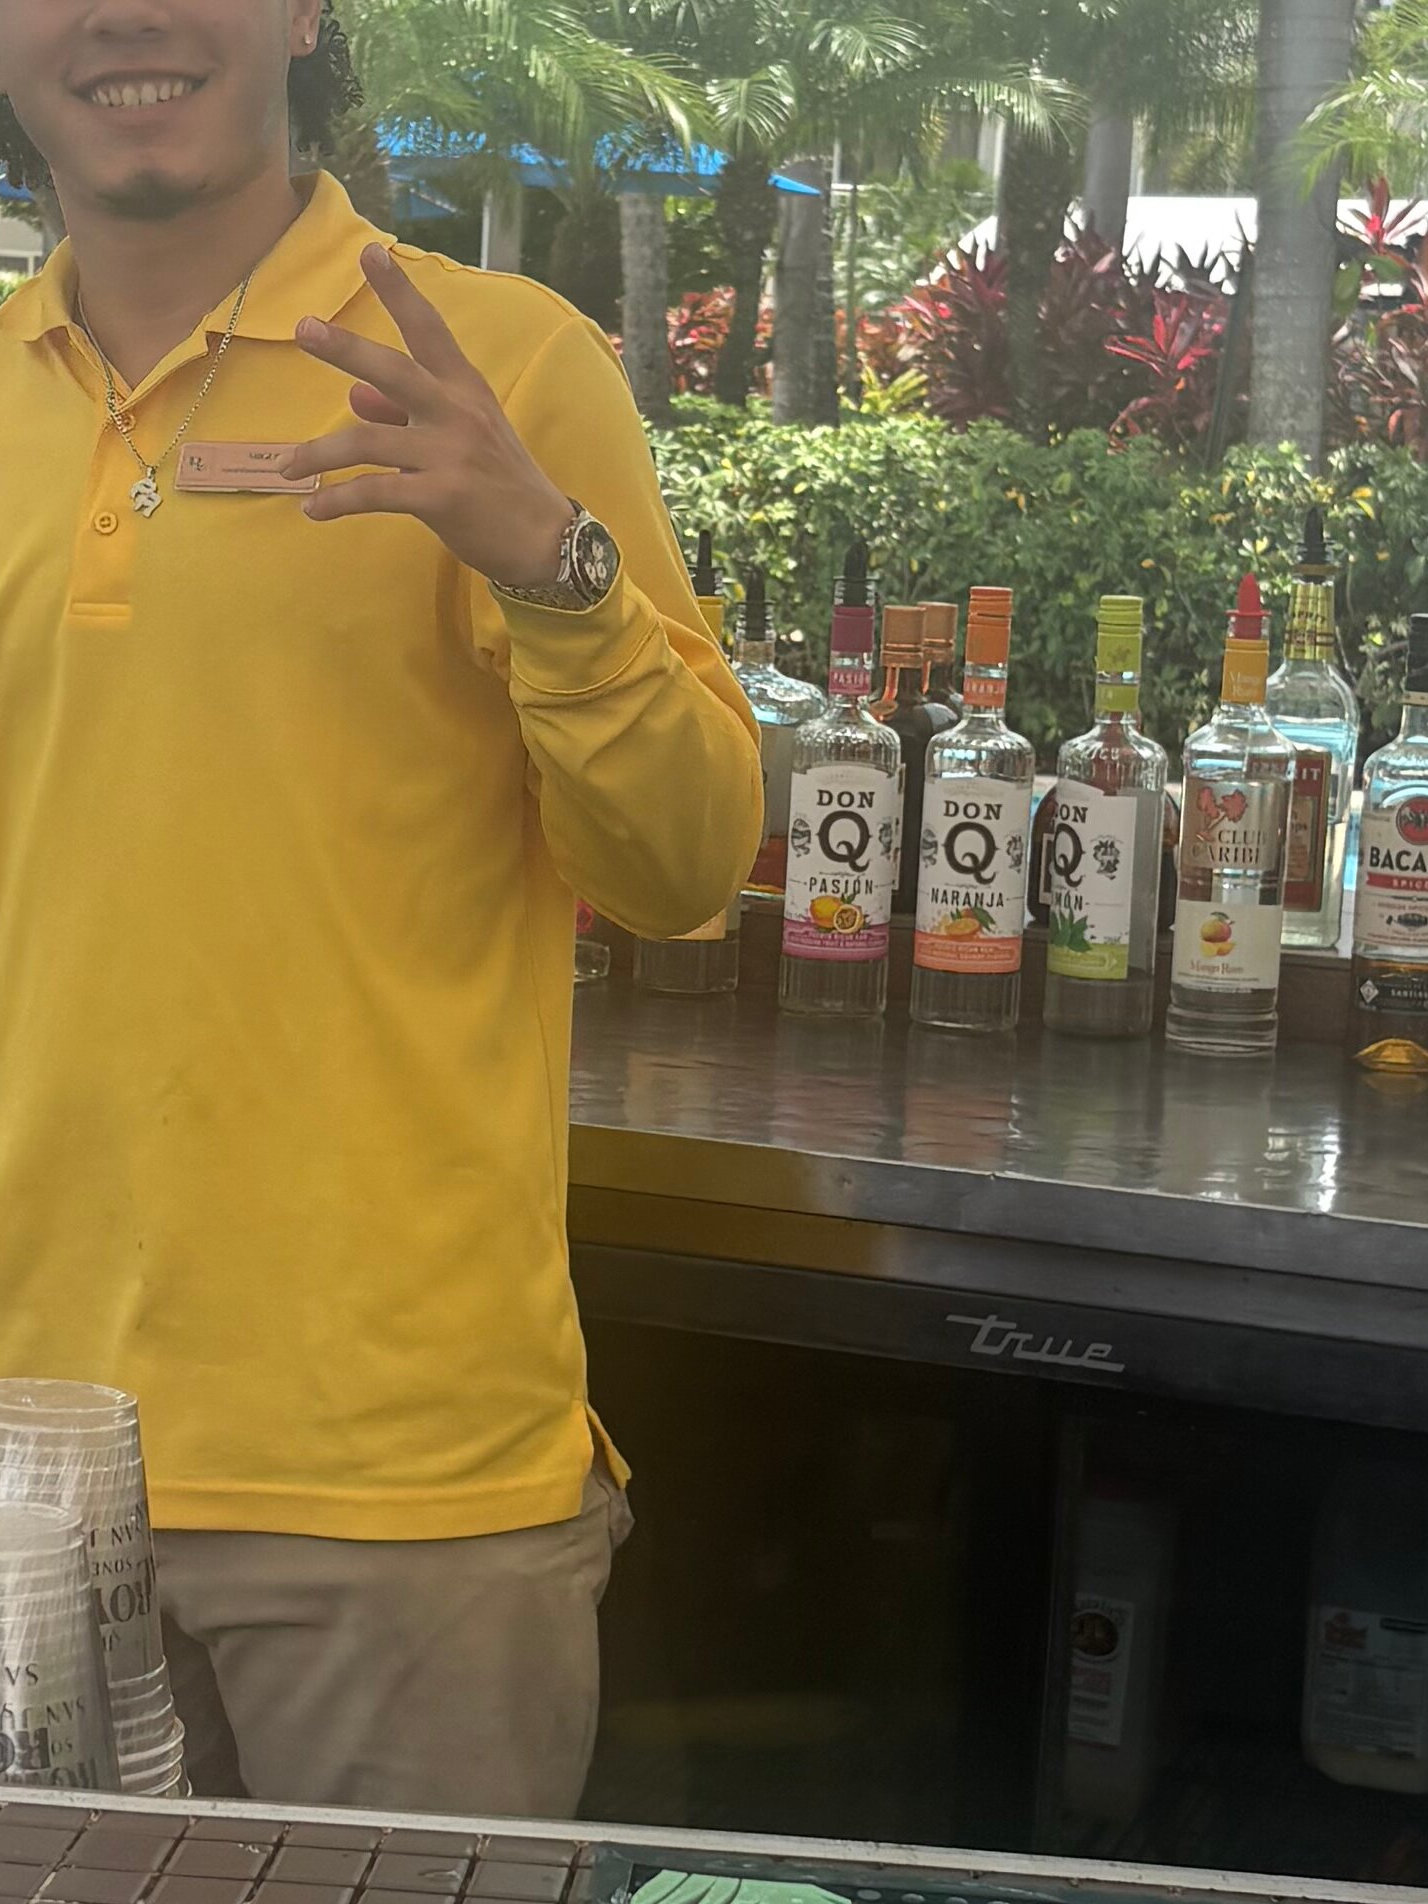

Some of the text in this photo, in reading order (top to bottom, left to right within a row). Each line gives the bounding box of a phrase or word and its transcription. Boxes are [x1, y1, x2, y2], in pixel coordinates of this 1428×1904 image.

[816, 788, 876, 809] DON
[943, 799, 1003, 821] DON
[1054, 805, 1088, 824] ON
[816, 810, 872, 874] Q
[942, 821, 999, 886] Q
[1053, 822, 1086, 888] Q
[808, 875, 874, 896] PASIÓN
[931, 887, 1006, 909] NARANJA
